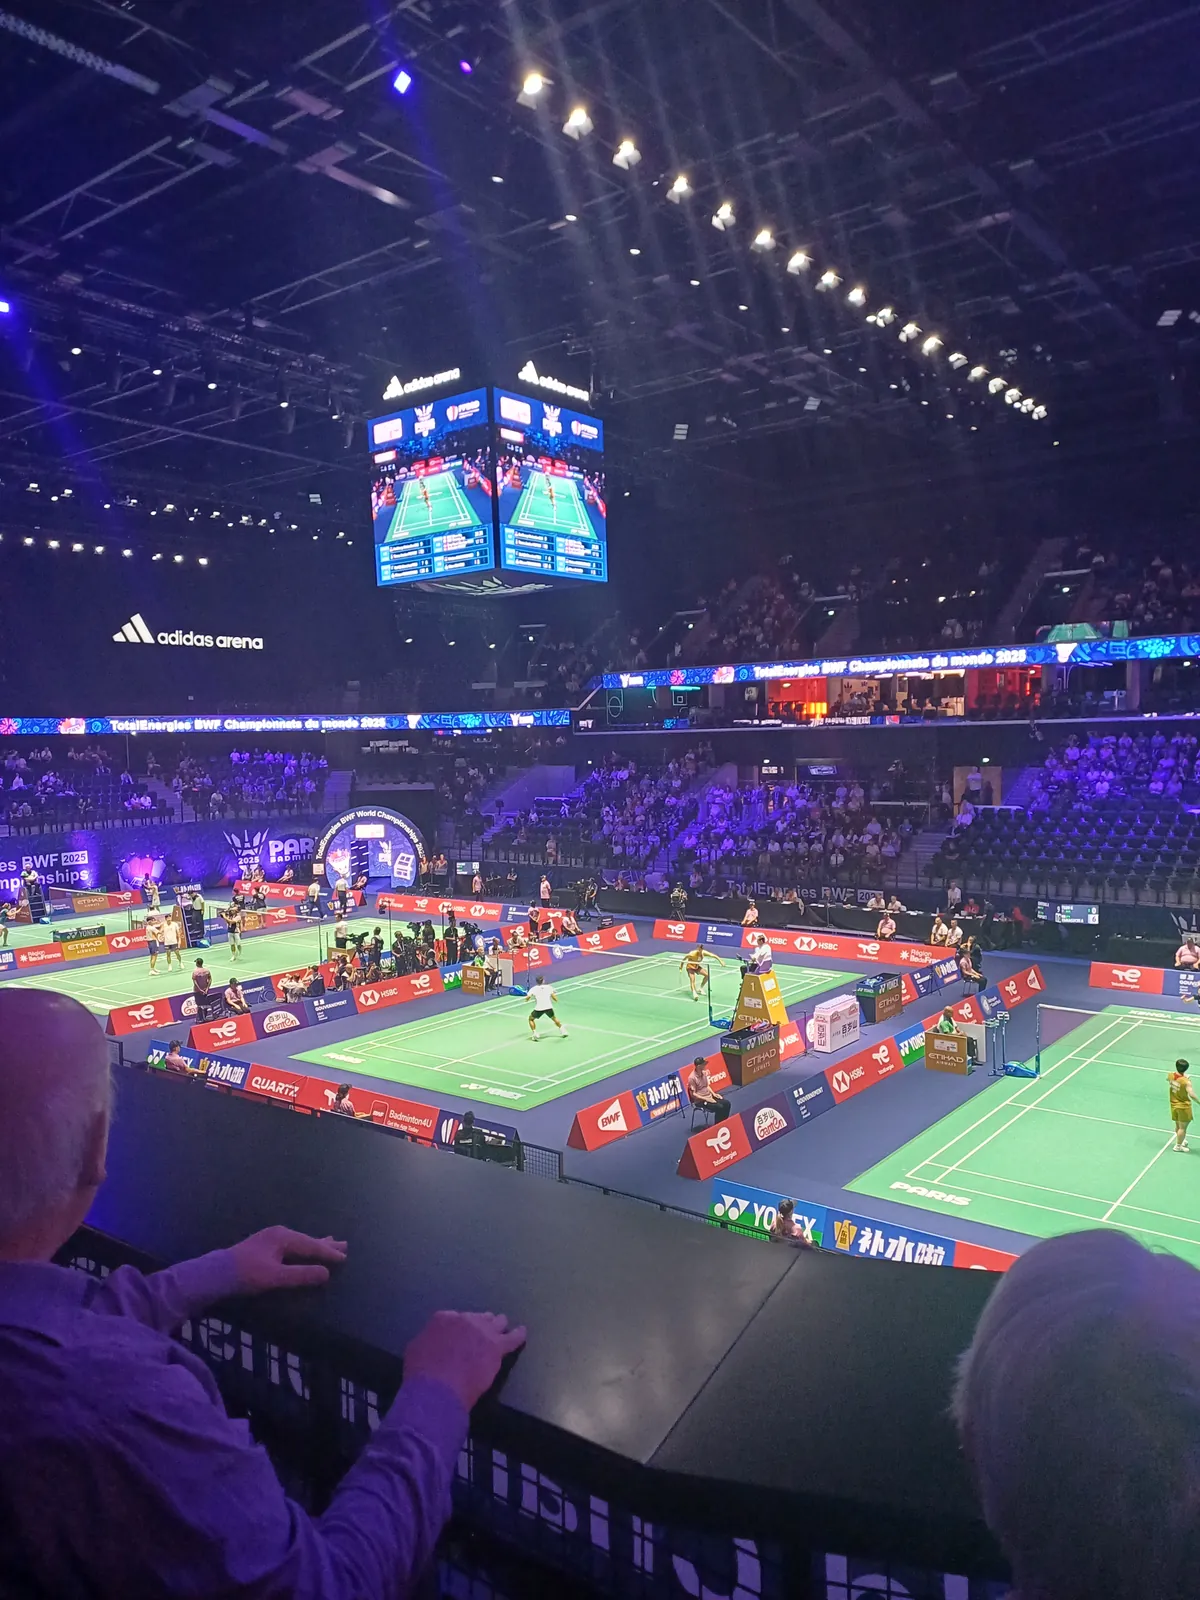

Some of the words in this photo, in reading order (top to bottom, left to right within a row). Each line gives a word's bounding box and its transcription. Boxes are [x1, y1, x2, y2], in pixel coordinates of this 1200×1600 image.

[157, 630, 214, 648] adidas
[215, 635, 264, 650] arena
[848, 655, 930, 674] Championnats
[931, 654, 948, 667] du
[949, 652, 994, 666] monde
[994, 648, 1027, 663] 2025
[110, 719, 193, 733] TotalEnergies
[194, 719, 221, 730] BWF
[224, 718, 302, 732] Championnats
[304, 718, 320, 729] du
[321, 718, 359, 729] monde
[360, 717, 386, 728] 2025
[315, 822, 342, 860] TotalEnergies
[340, 813, 356, 825] BWF
[356, 809, 376, 817] World
[376, 810, 419, 844] Championships
[268, 837, 318, 857] PAR
[22, 853, 59, 869] BWF
[63, 852, 87, 864] 2025
[238, 856, 260, 864] 2025
[0, 869, 89, 892] mpinships
[79, 929, 99, 937] YONEX
[67, 940, 103, 951] ETIHAD
[818, 942, 839, 950] HSBC
[911, 949, 932, 957] Région
[380, 987, 399, 998] HSBC
[750, 982, 755, 991] 1
[878, 994, 900, 1009] ETIHAD
[757, 1029, 775, 1046] YONEX
[784, 1034, 800, 1047] HSBC
[746, 1048, 777, 1068] ETIHAD
[928, 1052, 964, 1063] ETIHAD
[849, 1066, 865, 1081] HSBC
[251, 1076, 300, 1098] QUARTZ
[389, 1109, 433, 1128] Badminton4U
[601, 1110, 621, 1128] BWF
[889, 1181, 972, 1206] PARIS
[753, 1202, 817, 1240] YOEX
[858, 1226, 946, 1266] 补水啦
